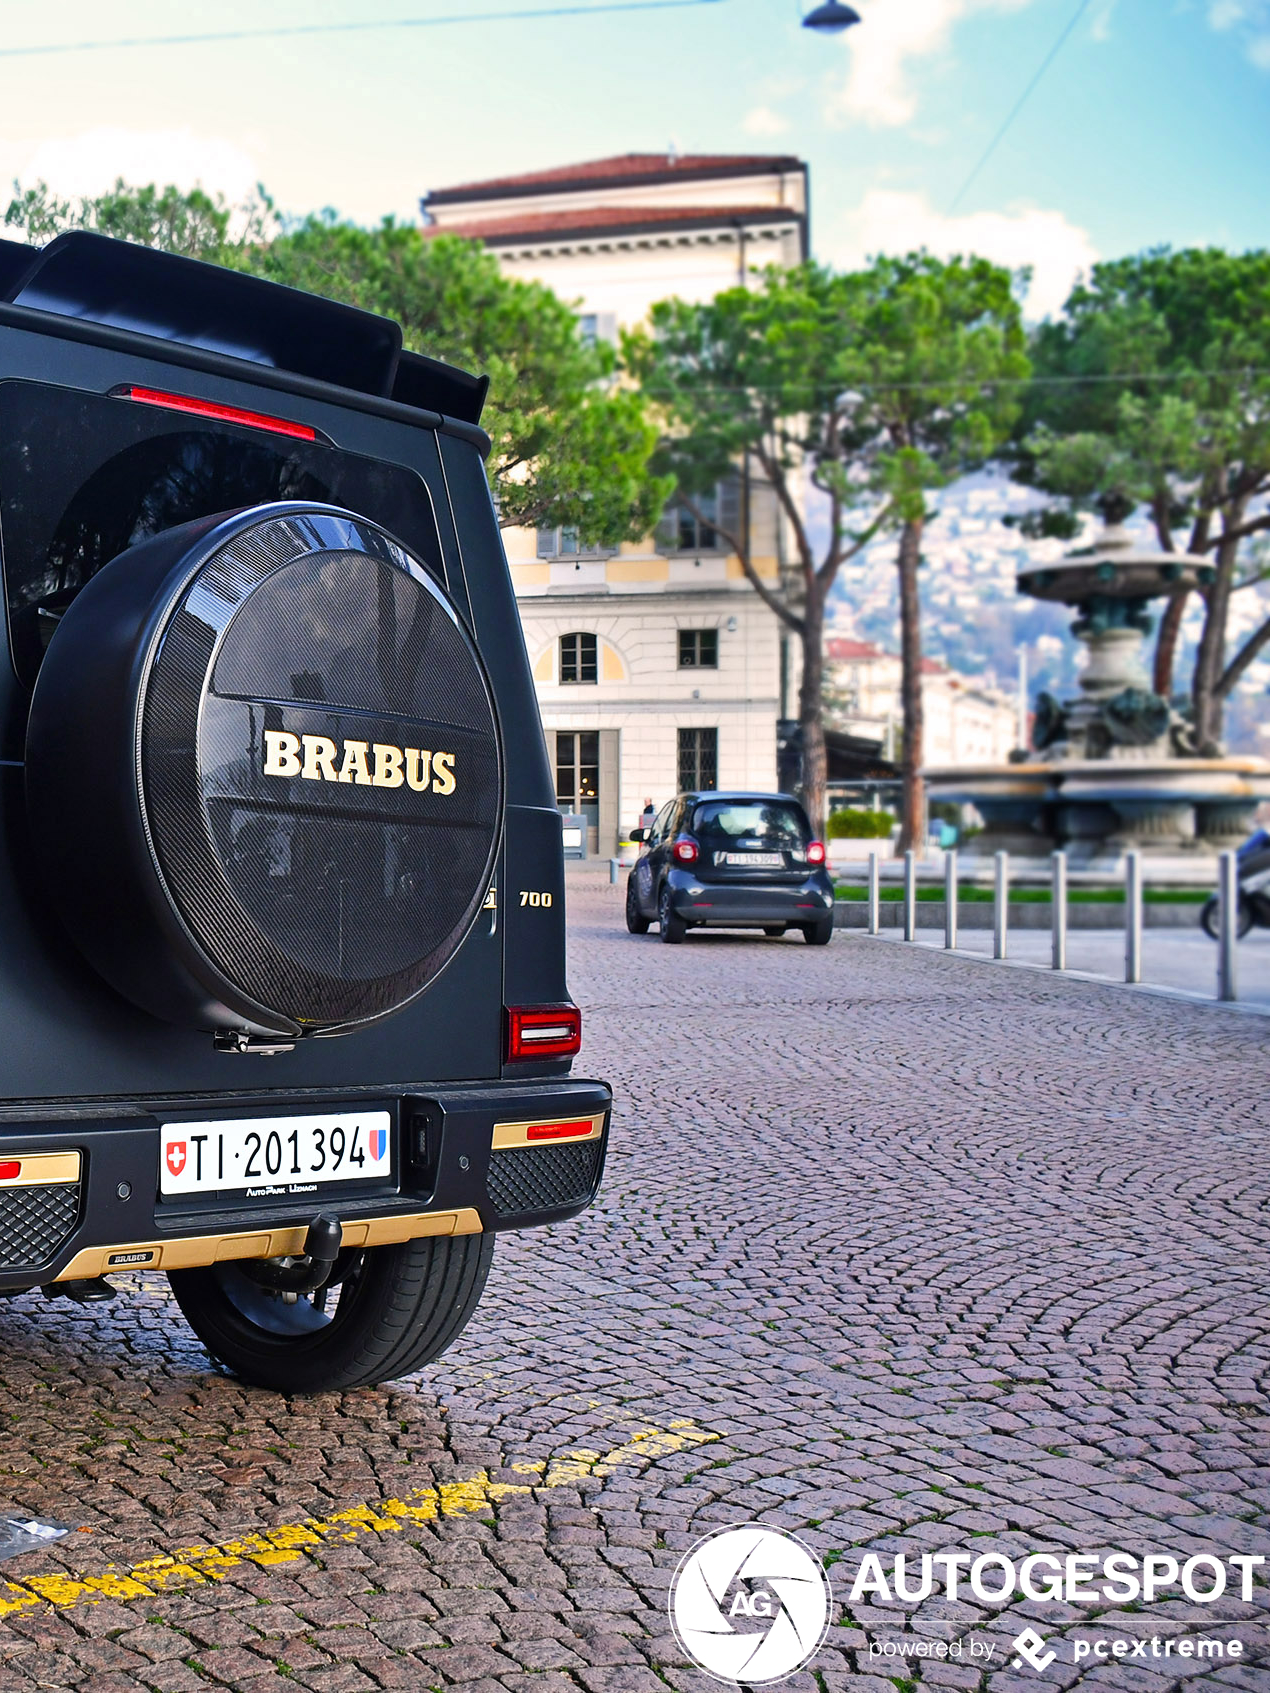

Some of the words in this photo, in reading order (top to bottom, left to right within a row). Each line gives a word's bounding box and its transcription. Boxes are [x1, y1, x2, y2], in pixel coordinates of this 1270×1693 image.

[263, 730, 457, 796] BRABUS
[519, 891, 552, 907] 700
[114, 1253, 147, 1263] BRABUS
